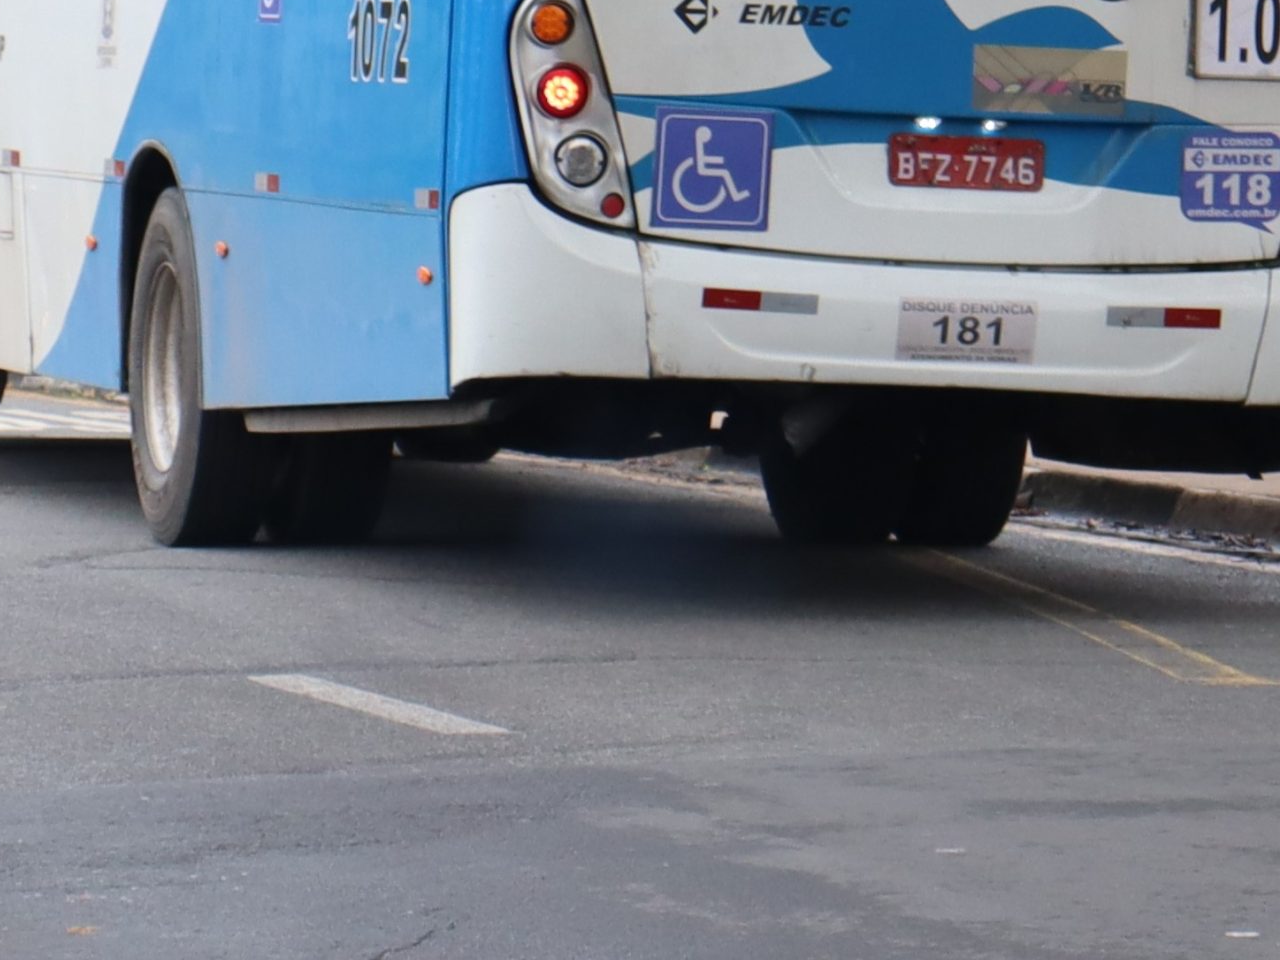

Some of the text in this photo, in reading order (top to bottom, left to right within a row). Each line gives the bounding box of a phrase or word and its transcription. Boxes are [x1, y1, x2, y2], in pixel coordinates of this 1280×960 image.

[738, 3, 852, 29] EMDEC
[1192, 137, 1274, 147] FALE CONOSCO
[1212, 153, 1273, 166] EMDEC
[1195, 173, 1272, 207] 118
[1186, 208, 1277, 219] emdec.com.br
[902, 301, 956, 314] DISQUE
[932, 315, 1004, 346] 181
